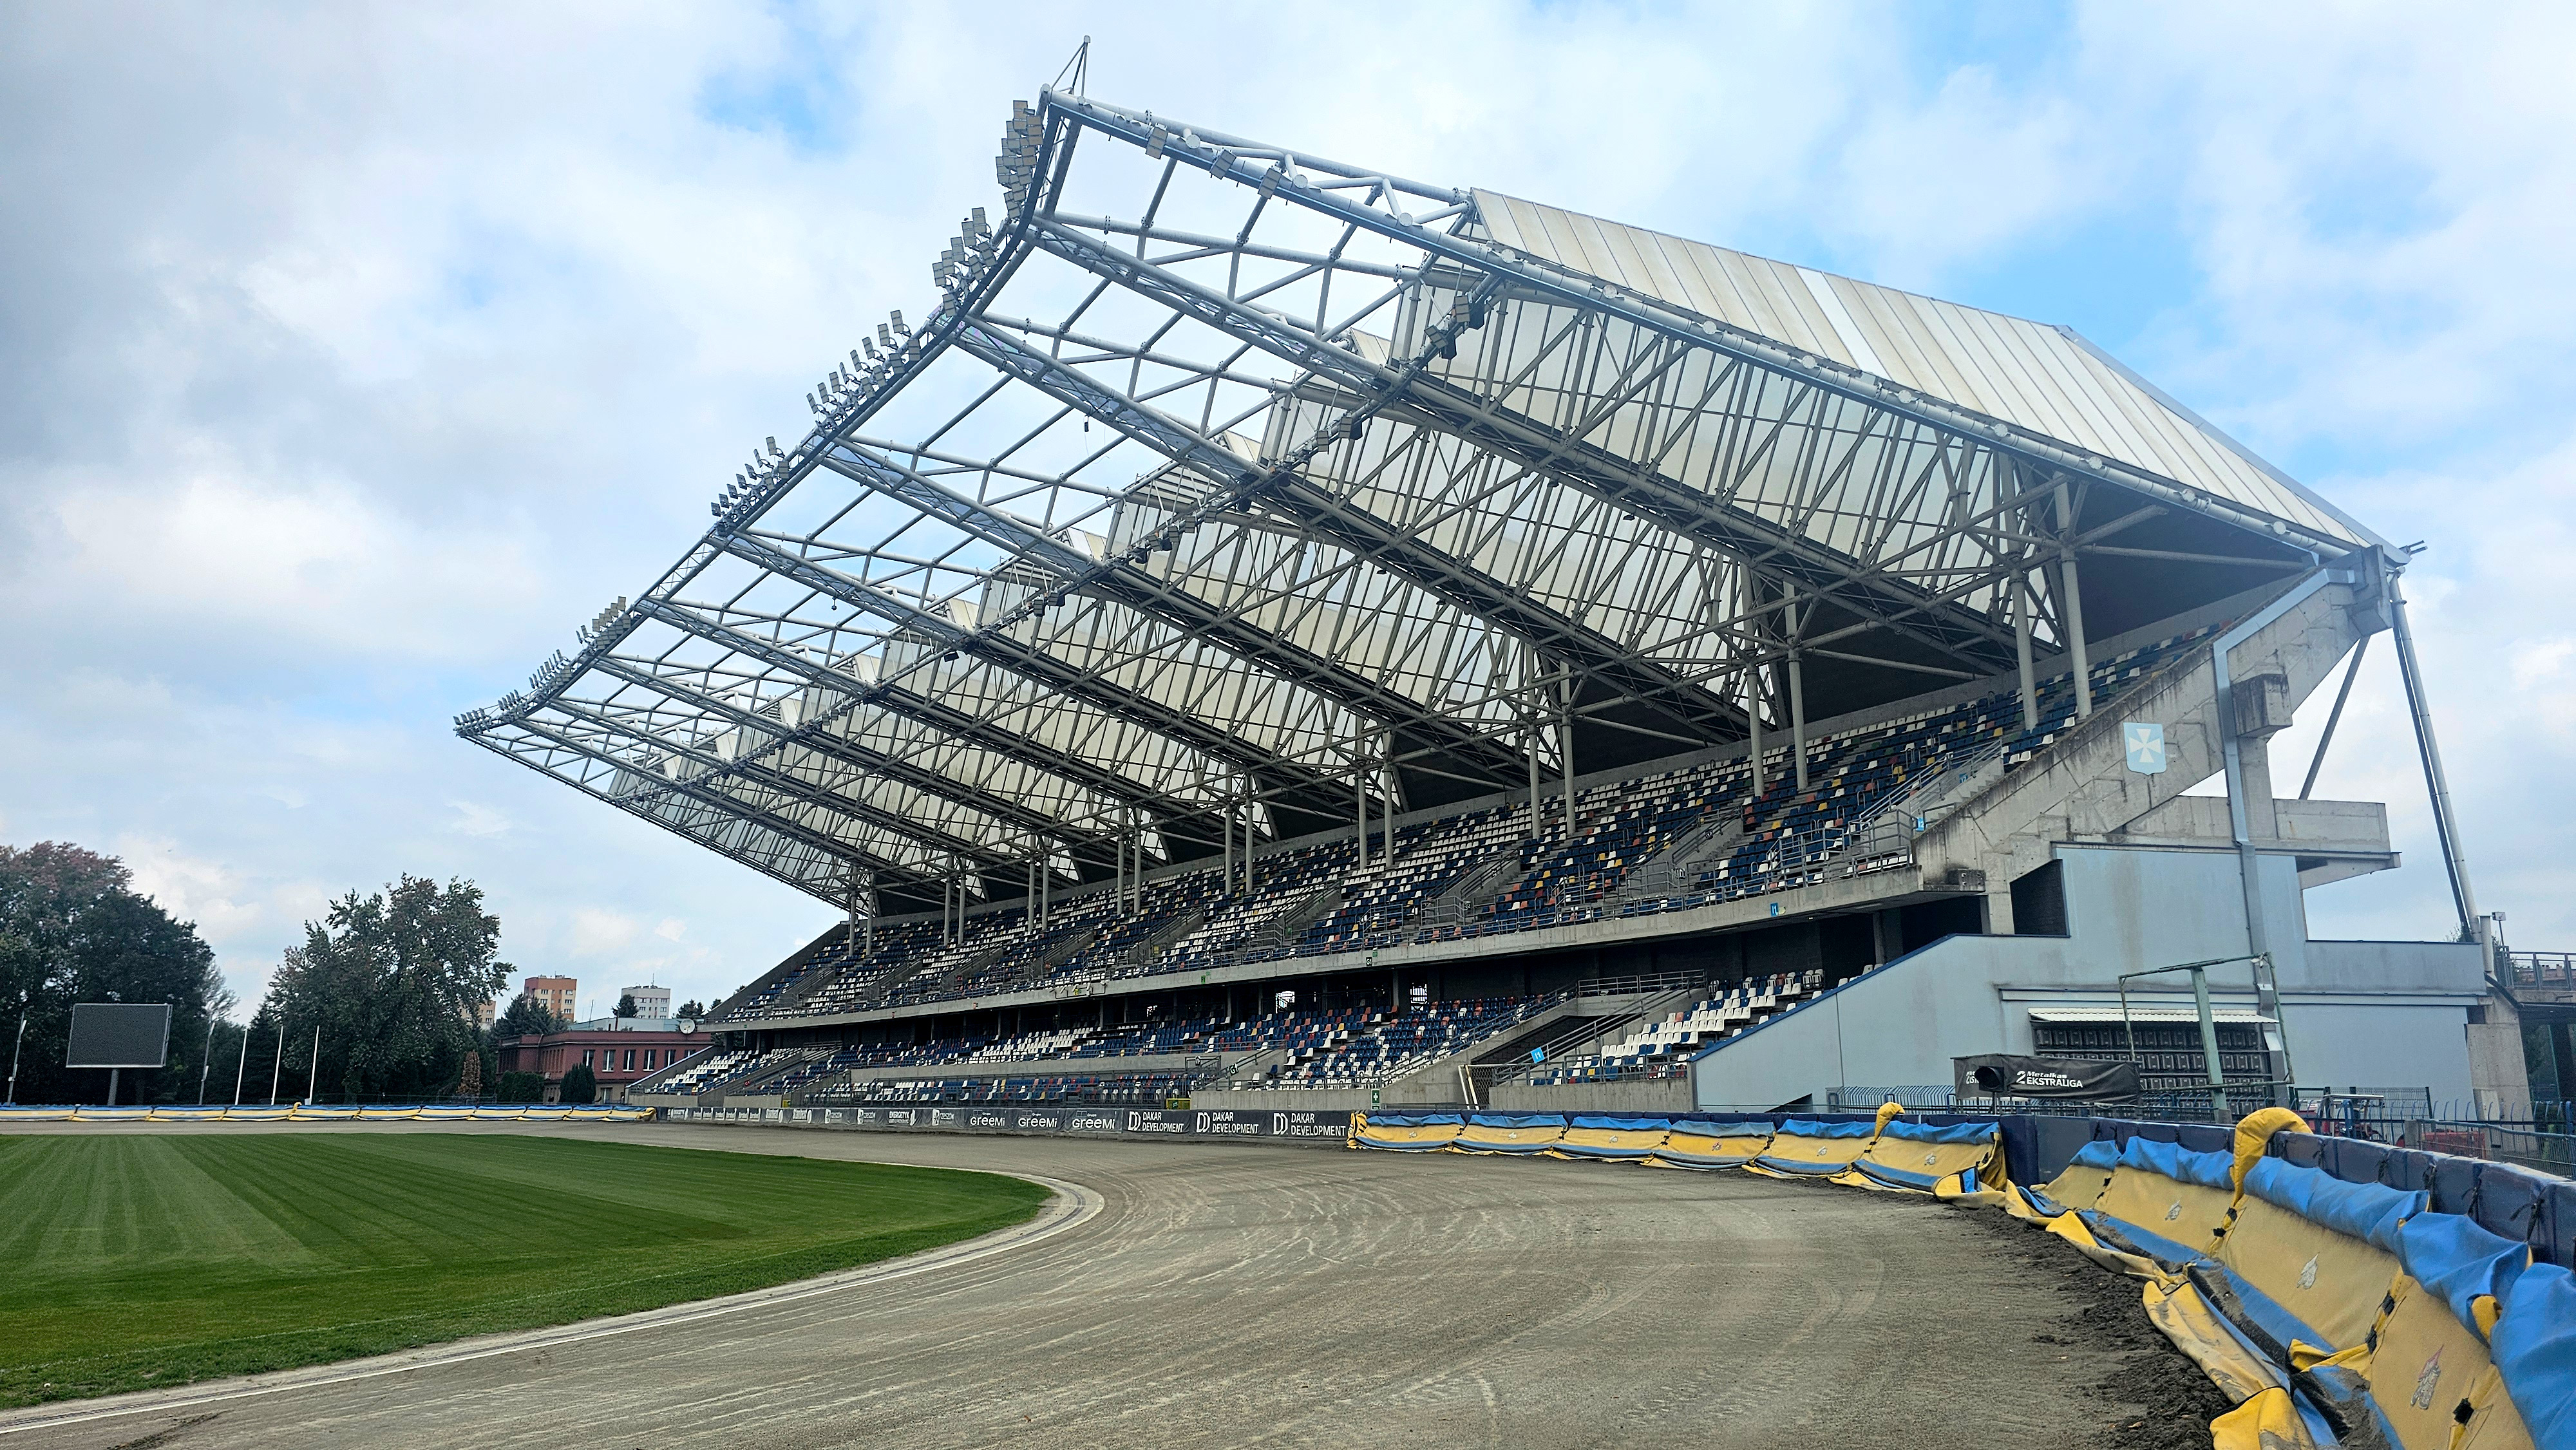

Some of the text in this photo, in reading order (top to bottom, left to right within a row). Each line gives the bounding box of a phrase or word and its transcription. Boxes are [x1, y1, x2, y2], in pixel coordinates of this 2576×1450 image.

[2027, 1071, 2068, 1079] Metalkas
[2026, 1077, 2083, 1088] EKSTRALIGA
[970, 1116, 1005, 1127] GreeMi
[1142, 1111, 1162, 1121] DAKAR
[1213, 1111, 1234, 1122] DAKAR
[1291, 1113, 1315, 1124] DAKAR
[1018, 1117, 1057, 1128] GreeMi
[1072, 1118, 1115, 1129] GreeMi
[1142, 1122, 1184, 1133] DEVELOPMENT
[1212, 1124, 1259, 1134] DEVELOPMENT
[1291, 1125, 1346, 1136] DEVELOPMENT
